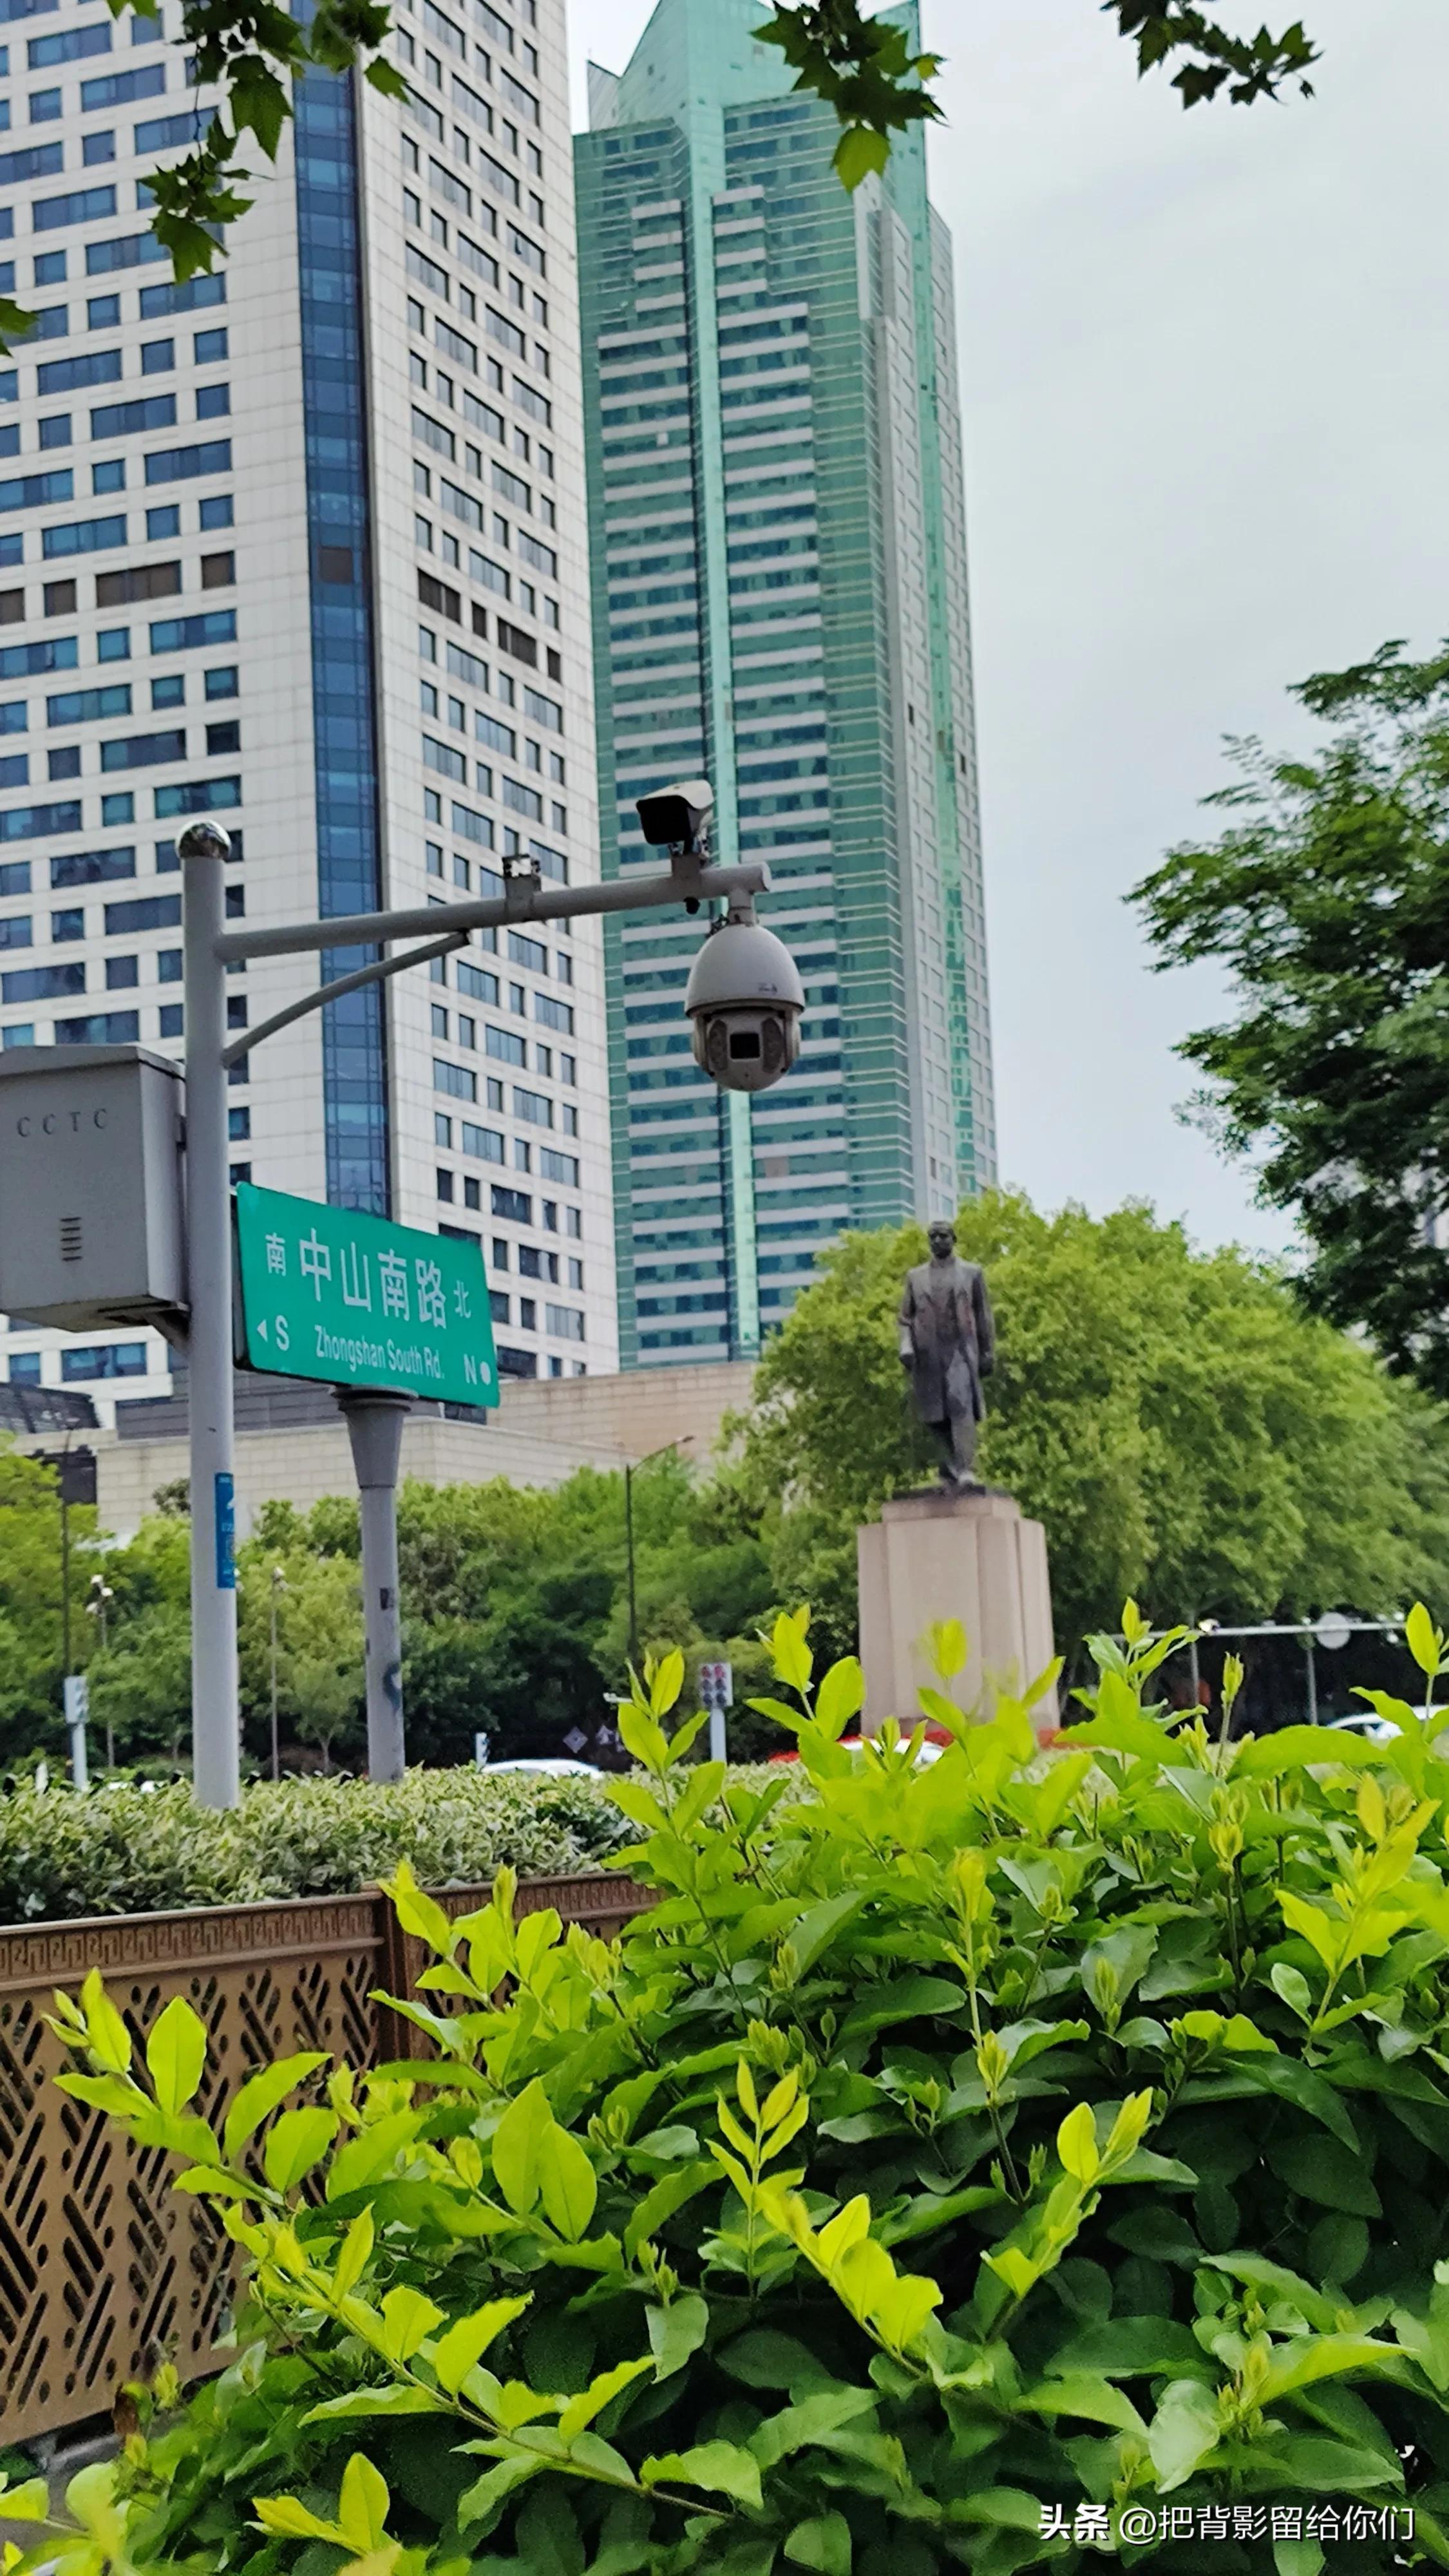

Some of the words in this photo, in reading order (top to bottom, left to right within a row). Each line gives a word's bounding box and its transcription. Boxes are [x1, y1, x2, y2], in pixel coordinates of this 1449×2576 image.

[265, 1233, 287, 1276] 南
[299, 1227, 447, 1329] 中山南路
[453, 1280, 471, 1319] 北
[276, 1314, 289, 1351] S
[314, 1324, 386, 1372] Zhongshan
[387, 1339, 422, 1375] South
[424, 1347, 445, 1379] Rd.
[463, 1354, 478, 1385] N
